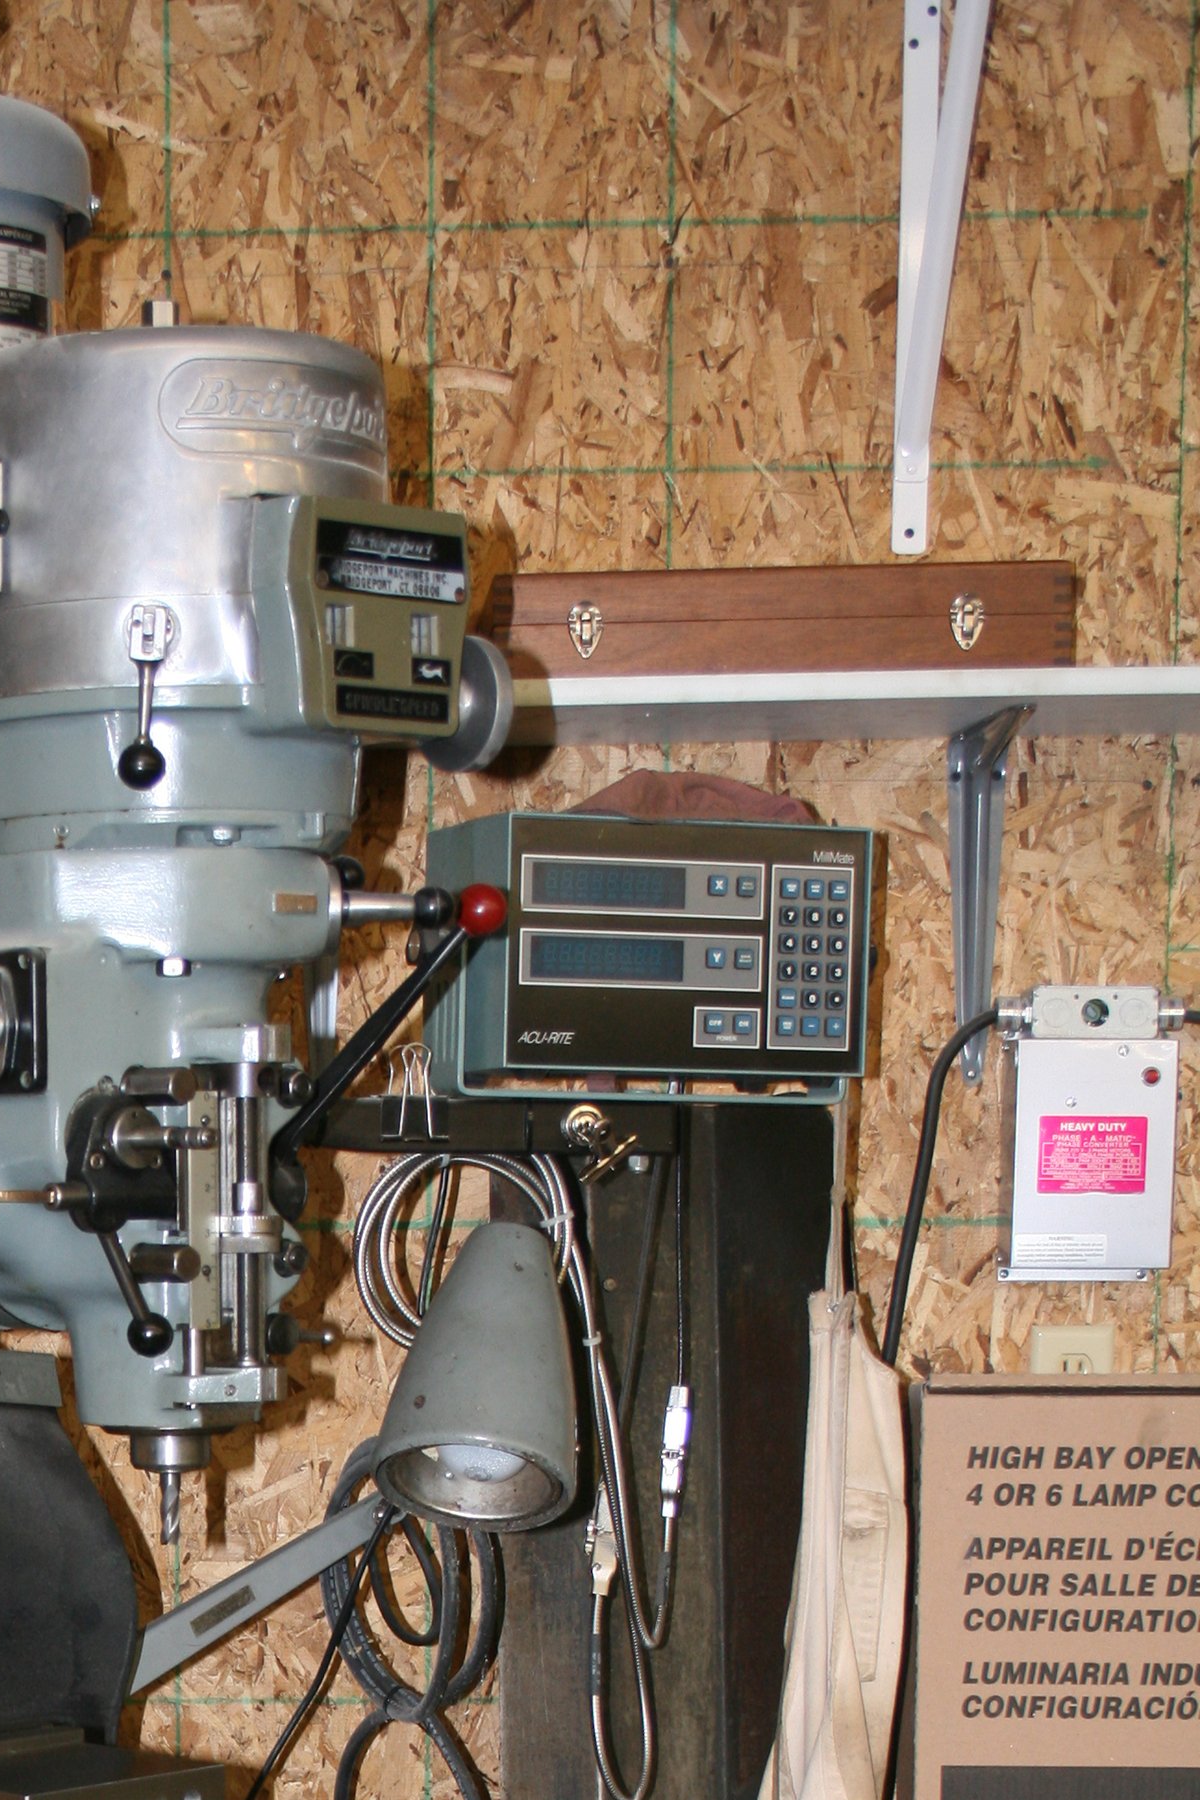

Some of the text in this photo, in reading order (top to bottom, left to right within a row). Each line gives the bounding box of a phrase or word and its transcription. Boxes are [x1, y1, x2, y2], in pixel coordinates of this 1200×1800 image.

[387, 566, 430, 583] MACHINES
[431, 571, 449, 585] INC.
[812, 850, 856, 865] MillMate
[715, 879, 724, 890] X
[787, 912, 844, 923] 7 8 9
[785, 938, 842, 950] 4 5 6
[712, 952, 721, 963] Y
[785, 966, 842, 978] 1 2 3
[808, 994, 816, 1003] 0
[517, 1030, 575, 1046] ACU-RITE
[1060, 1122, 1127, 1132] HEAVY DUTY
[1052, 1134, 1081, 1142] PHASE
[966, 1446, 1200, 1470] HIGH BAY OPEN
[965, 1483, 1200, 1508] 4 OR 6 LAMP CO
[963, 1530, 1200, 1562] APPAREIL D'ÉC
[963, 1573, 1200, 1598] POUR SALLE DE
[963, 1608, 1200, 1633] CONFIGURATIO
[961, 1661, 1130, 1685] LUMINARIA
[961, 1690, 1200, 1720] CONFIGURACIÓ
